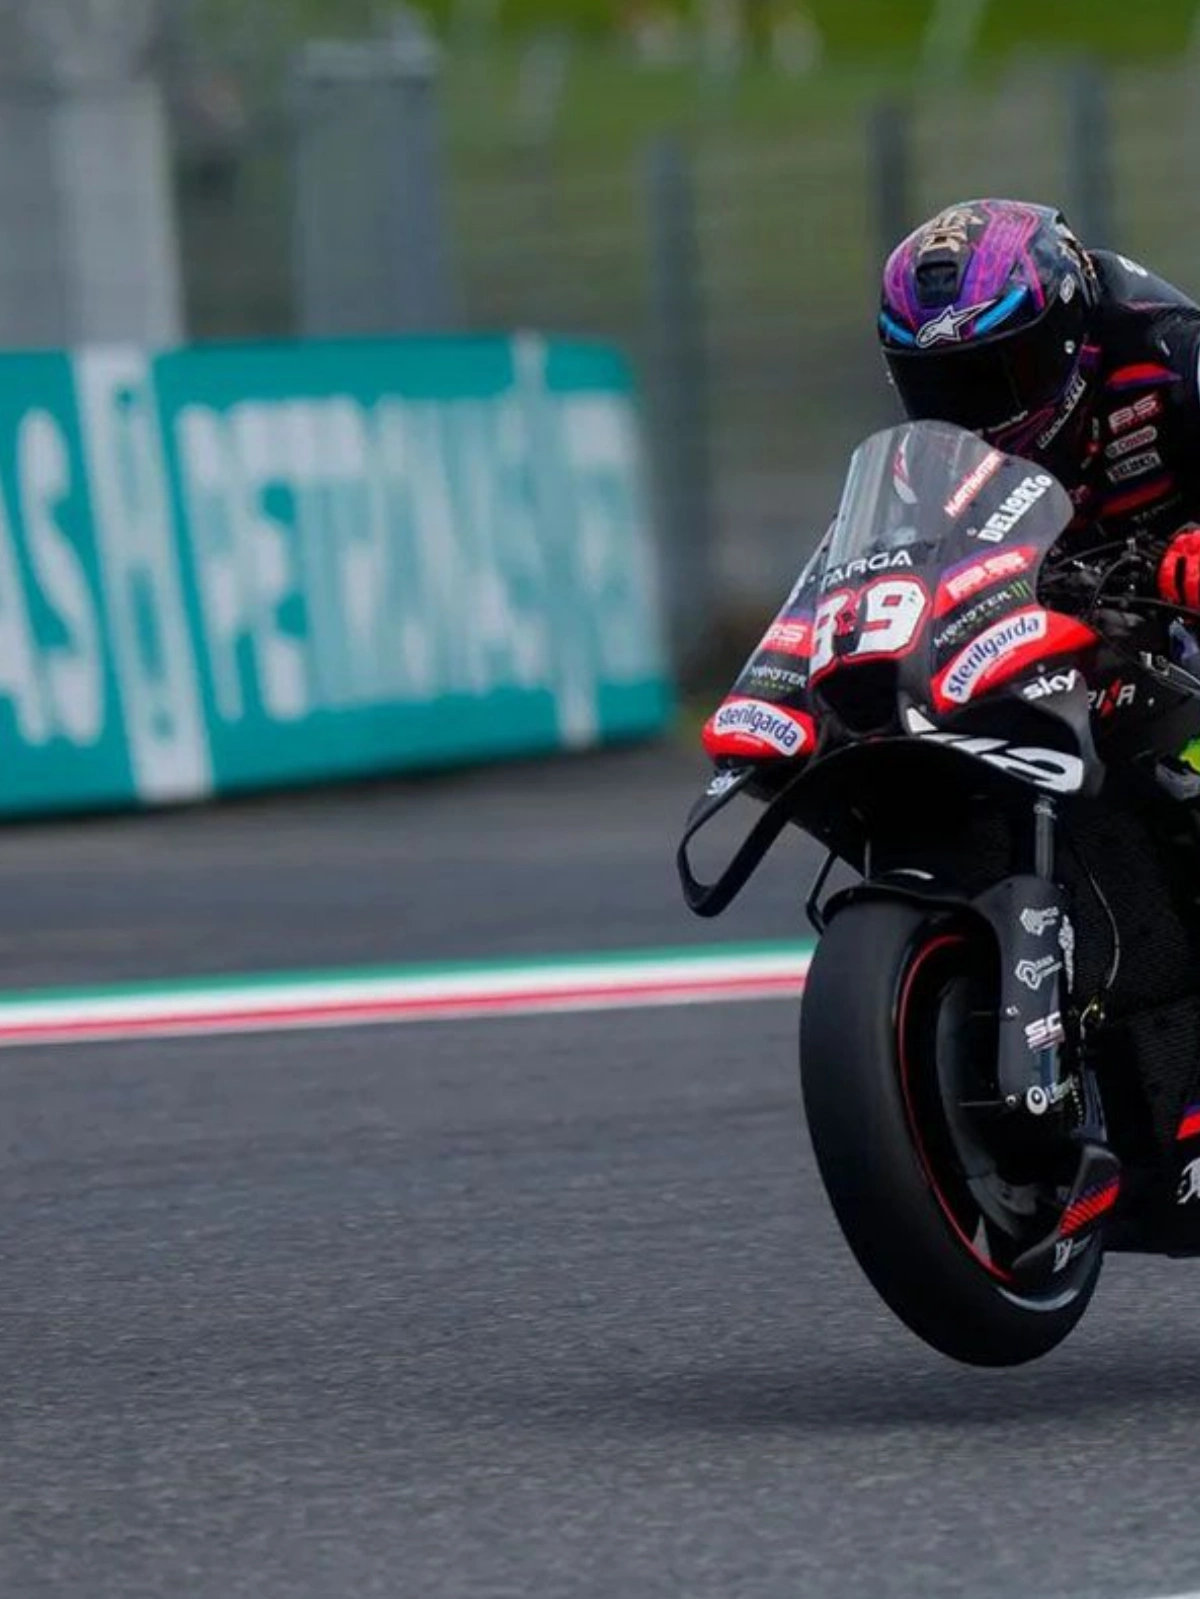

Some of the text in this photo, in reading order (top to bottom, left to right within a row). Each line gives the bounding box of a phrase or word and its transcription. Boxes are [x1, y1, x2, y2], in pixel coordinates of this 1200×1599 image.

[948, 617, 1040, 697] sterilgarda
[1022, 669, 1077, 700] sky
[718, 704, 797, 748] sterilgarda
